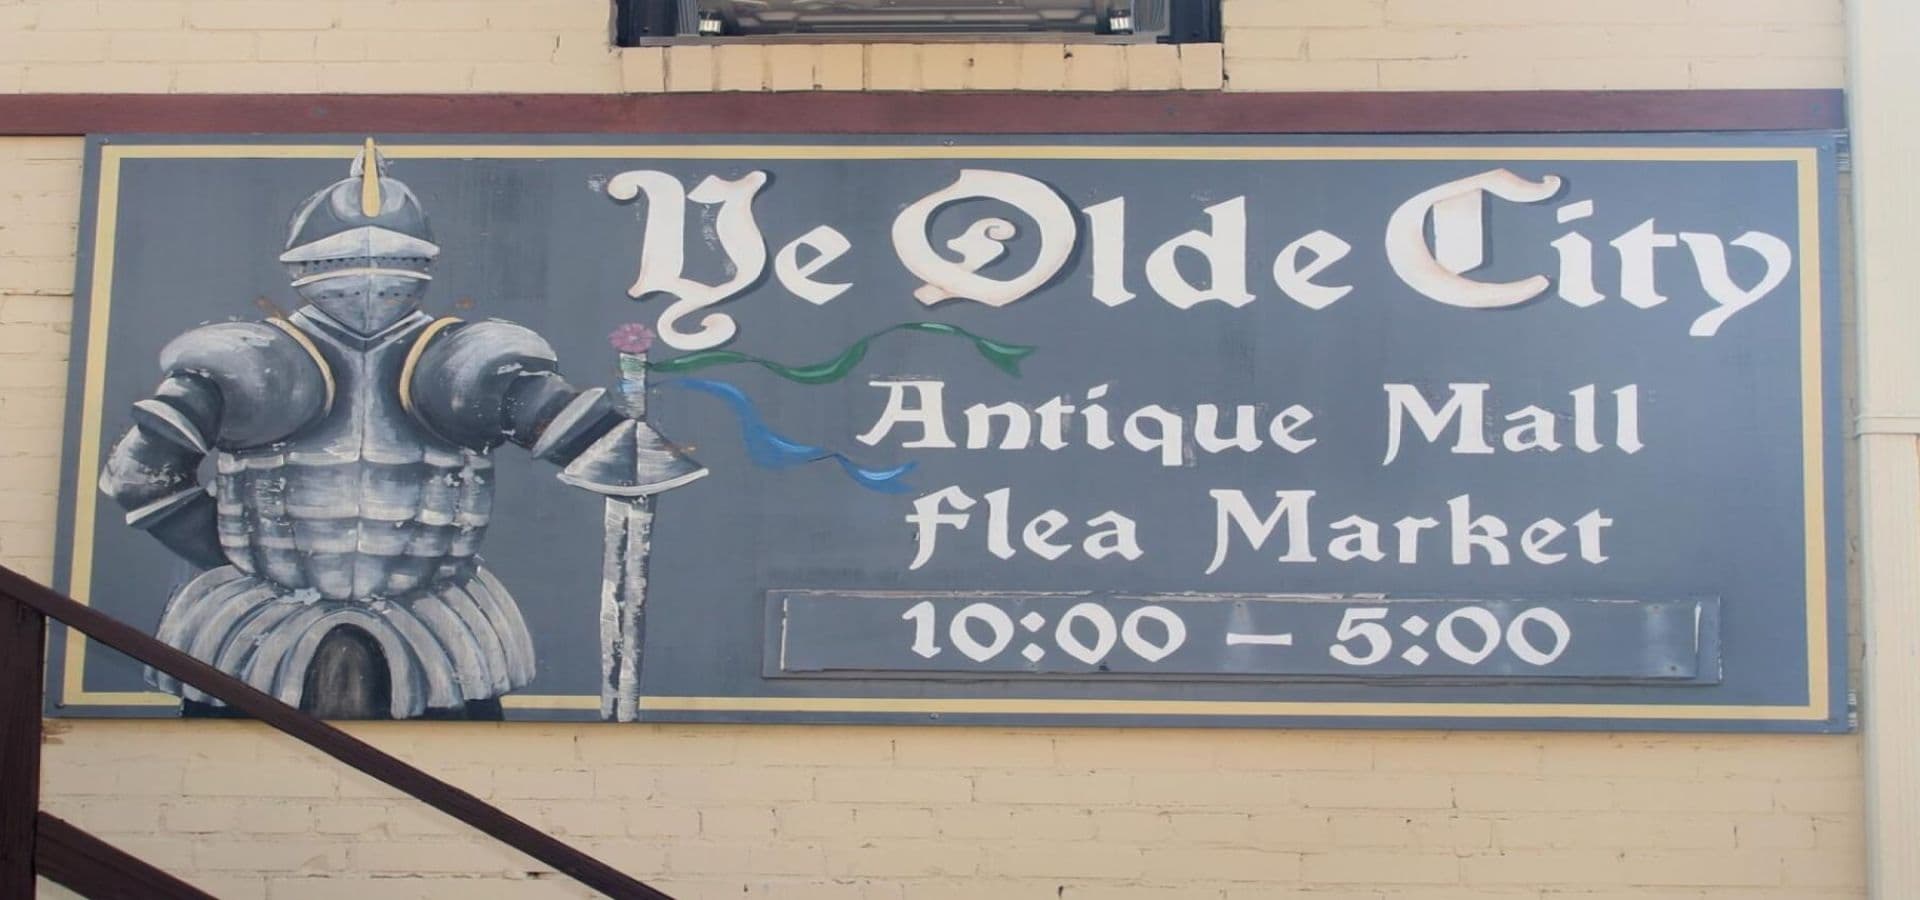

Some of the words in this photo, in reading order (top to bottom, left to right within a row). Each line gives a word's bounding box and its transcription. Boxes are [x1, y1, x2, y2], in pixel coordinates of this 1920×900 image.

[608, 169, 853, 351] Ye
[891, 169, 1354, 310] Olde
[1384, 168, 1793, 337] City
[855, 379, 1318, 467] Antique
[1382, 382, 1645, 466] Mall
[1205, 489, 1613, 575] Market
[901, 600, 1187, 665] 10:00
[1329, 606, 1571, 666] 5:00
